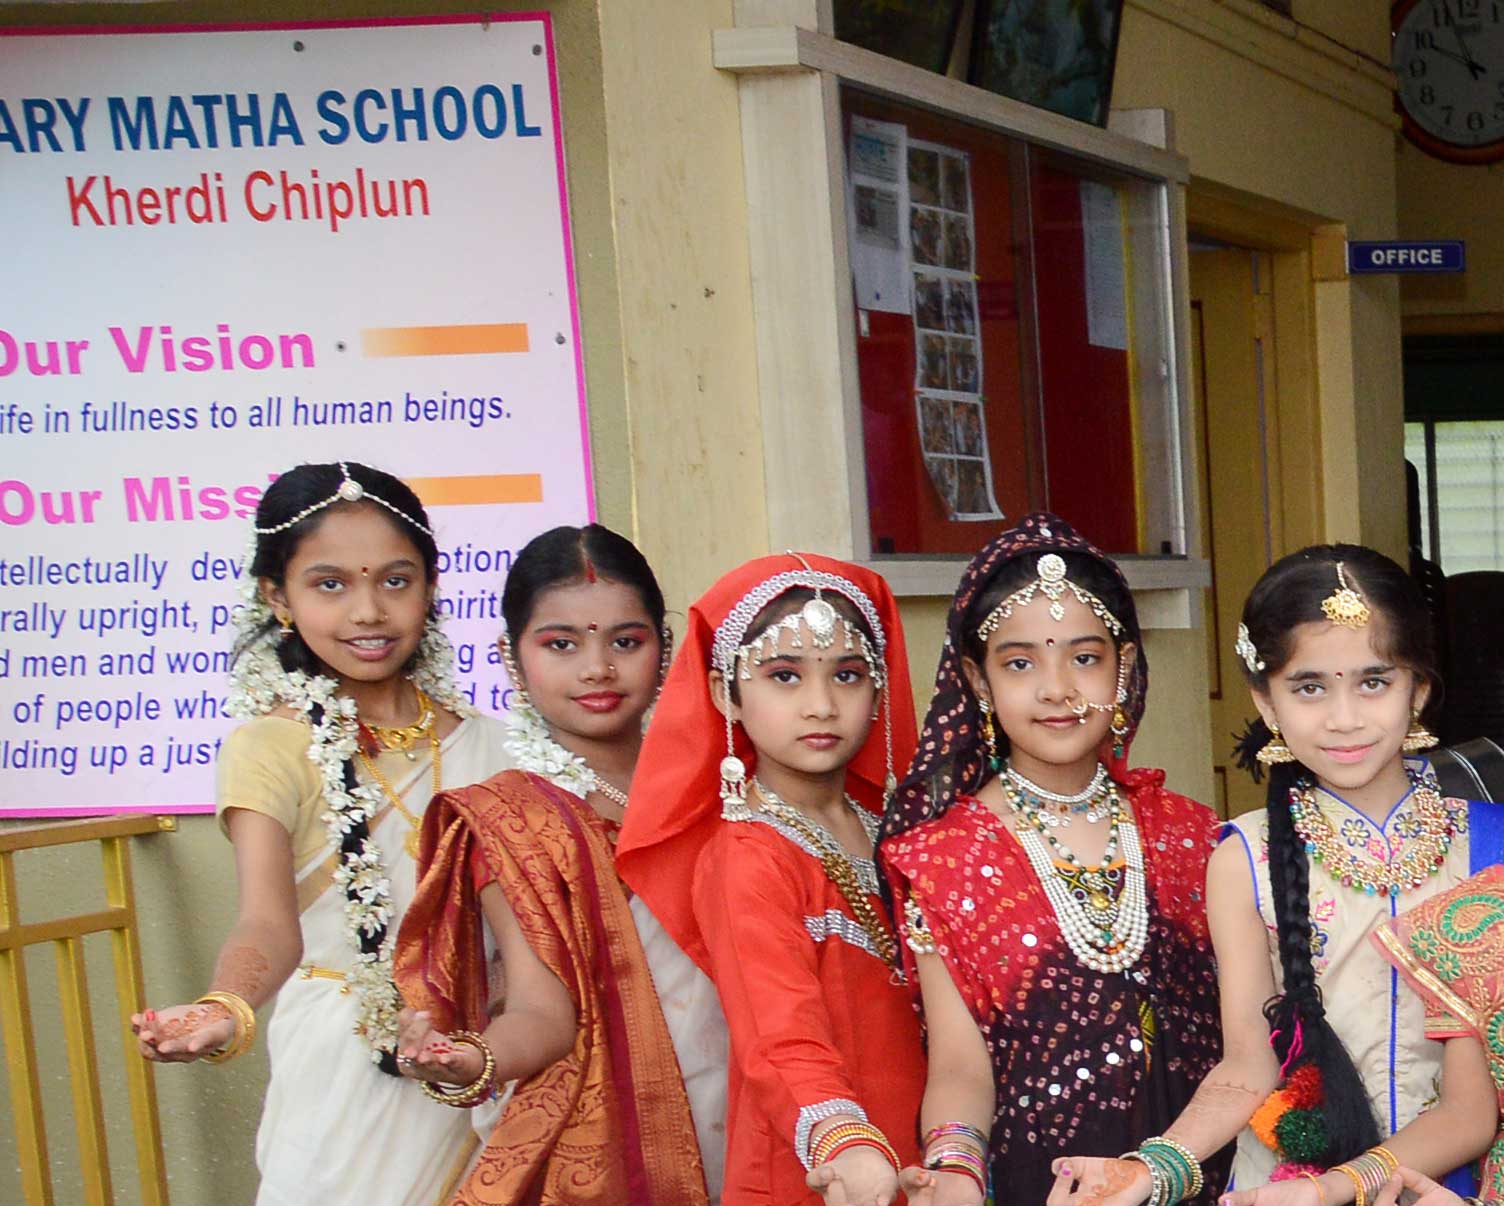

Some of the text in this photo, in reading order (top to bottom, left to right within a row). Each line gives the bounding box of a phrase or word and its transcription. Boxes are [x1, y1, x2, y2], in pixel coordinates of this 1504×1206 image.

[107, 92, 305, 150] MATHA
[316, 83, 542, 146] SCHOOL
[66, 168, 430, 233] Kherdi Chiplun
[1371, 248, 1443, 265] OFFICE
[107, 323, 315, 374] Vision
[44, 403, 70, 433] in
[81, 401, 199, 433] fullness
[210, 401, 238, 429] to
[249, 396, 281, 427] all
[293, 396, 393, 426] human
[404, 390, 511, 428] beings.
[0, 474, 282, 526] Our Miss
[79, 599, 198, 638] upright,
[22, 652, 87, 678] men
[99, 646, 155, 676] and
[13, 694, 45, 723] of
[56, 692, 161, 730] people
[90, 746, 127, 774] up
[139, 745, 154, 766] a
